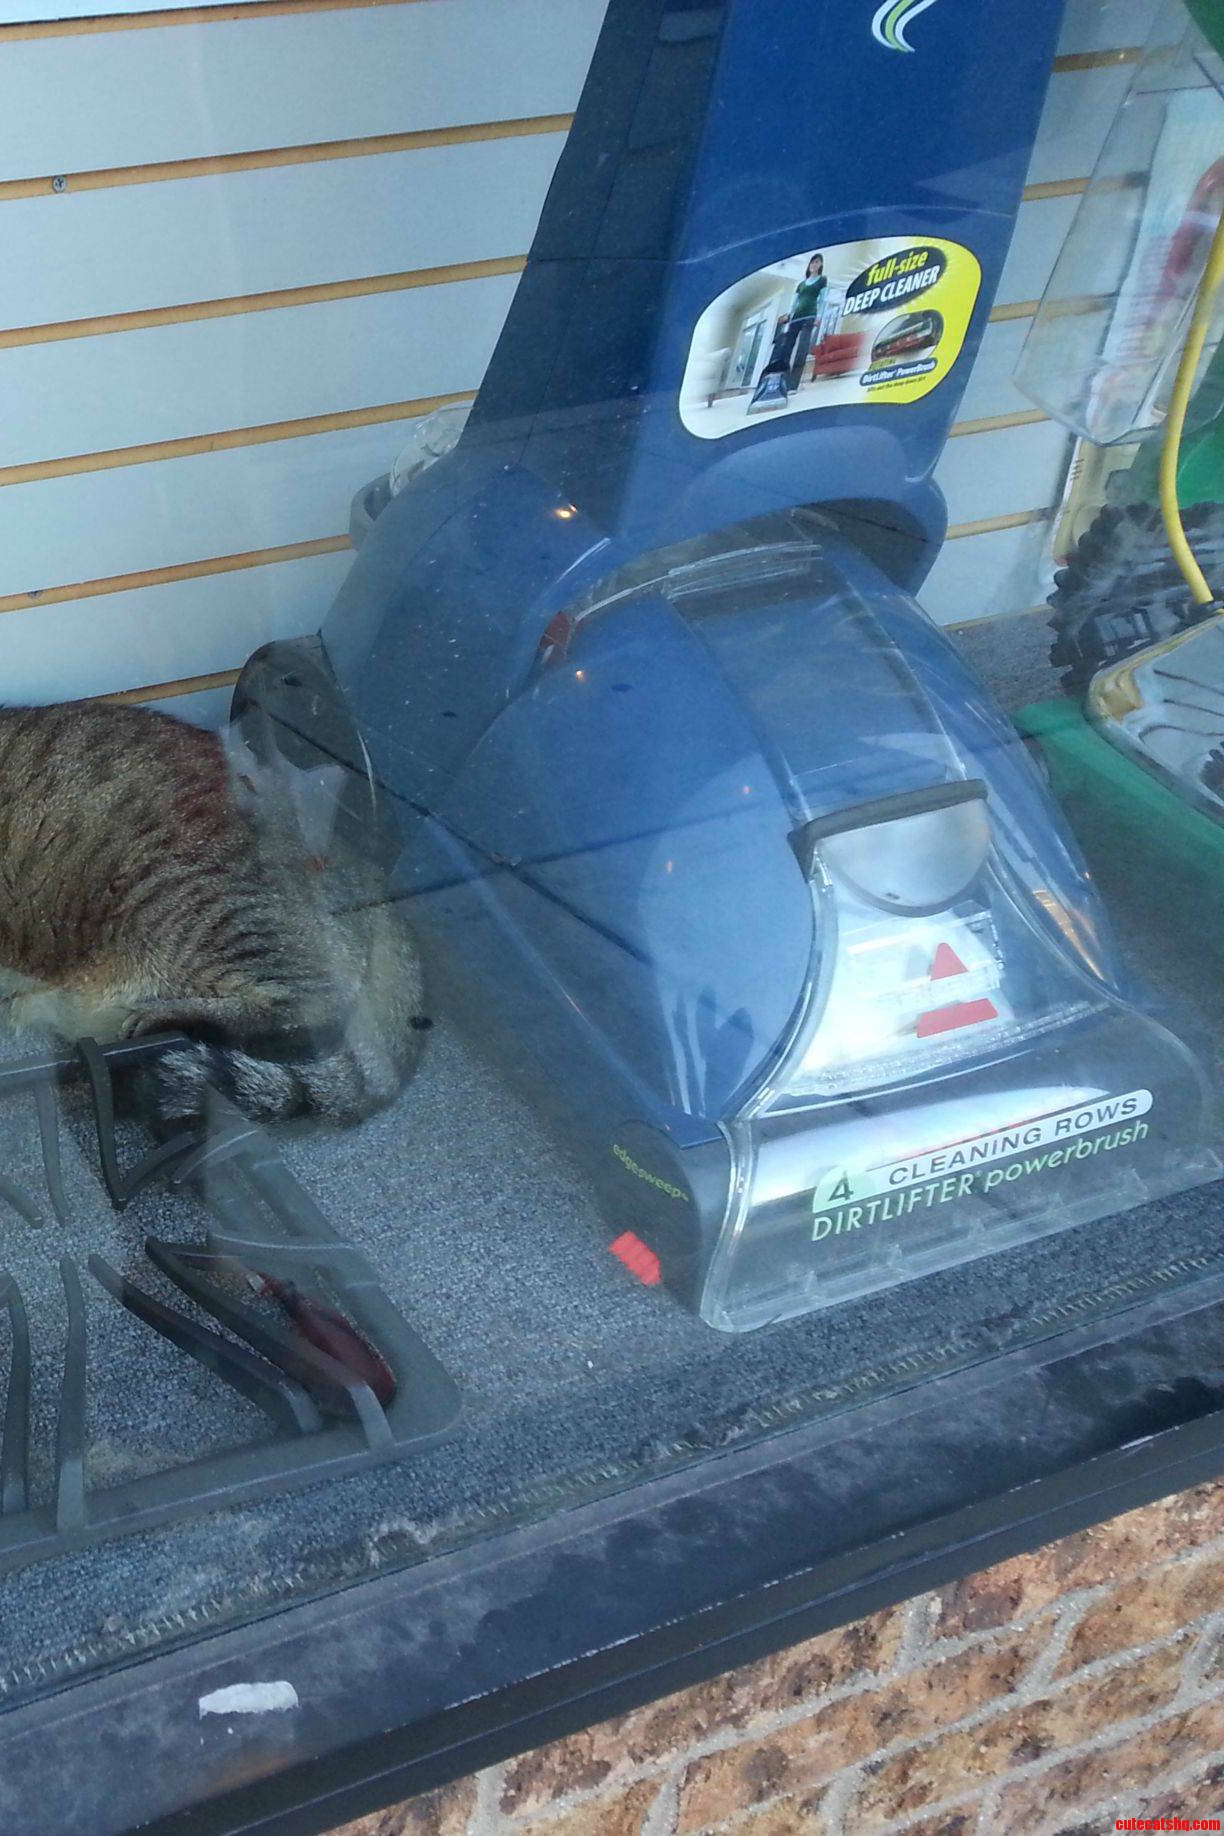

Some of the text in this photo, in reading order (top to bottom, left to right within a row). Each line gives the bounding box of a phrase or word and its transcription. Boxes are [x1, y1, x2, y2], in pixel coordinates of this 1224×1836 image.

[842, 265, 940, 317] DEEP CLEANER
[866, 251, 928, 286] full-size
[889, 1097, 1137, 1185] CLEANING ROWS
[812, 1119, 1149, 1241] DIRTLIFTER powerbrush
[828, 1169, 853, 1202] 4
